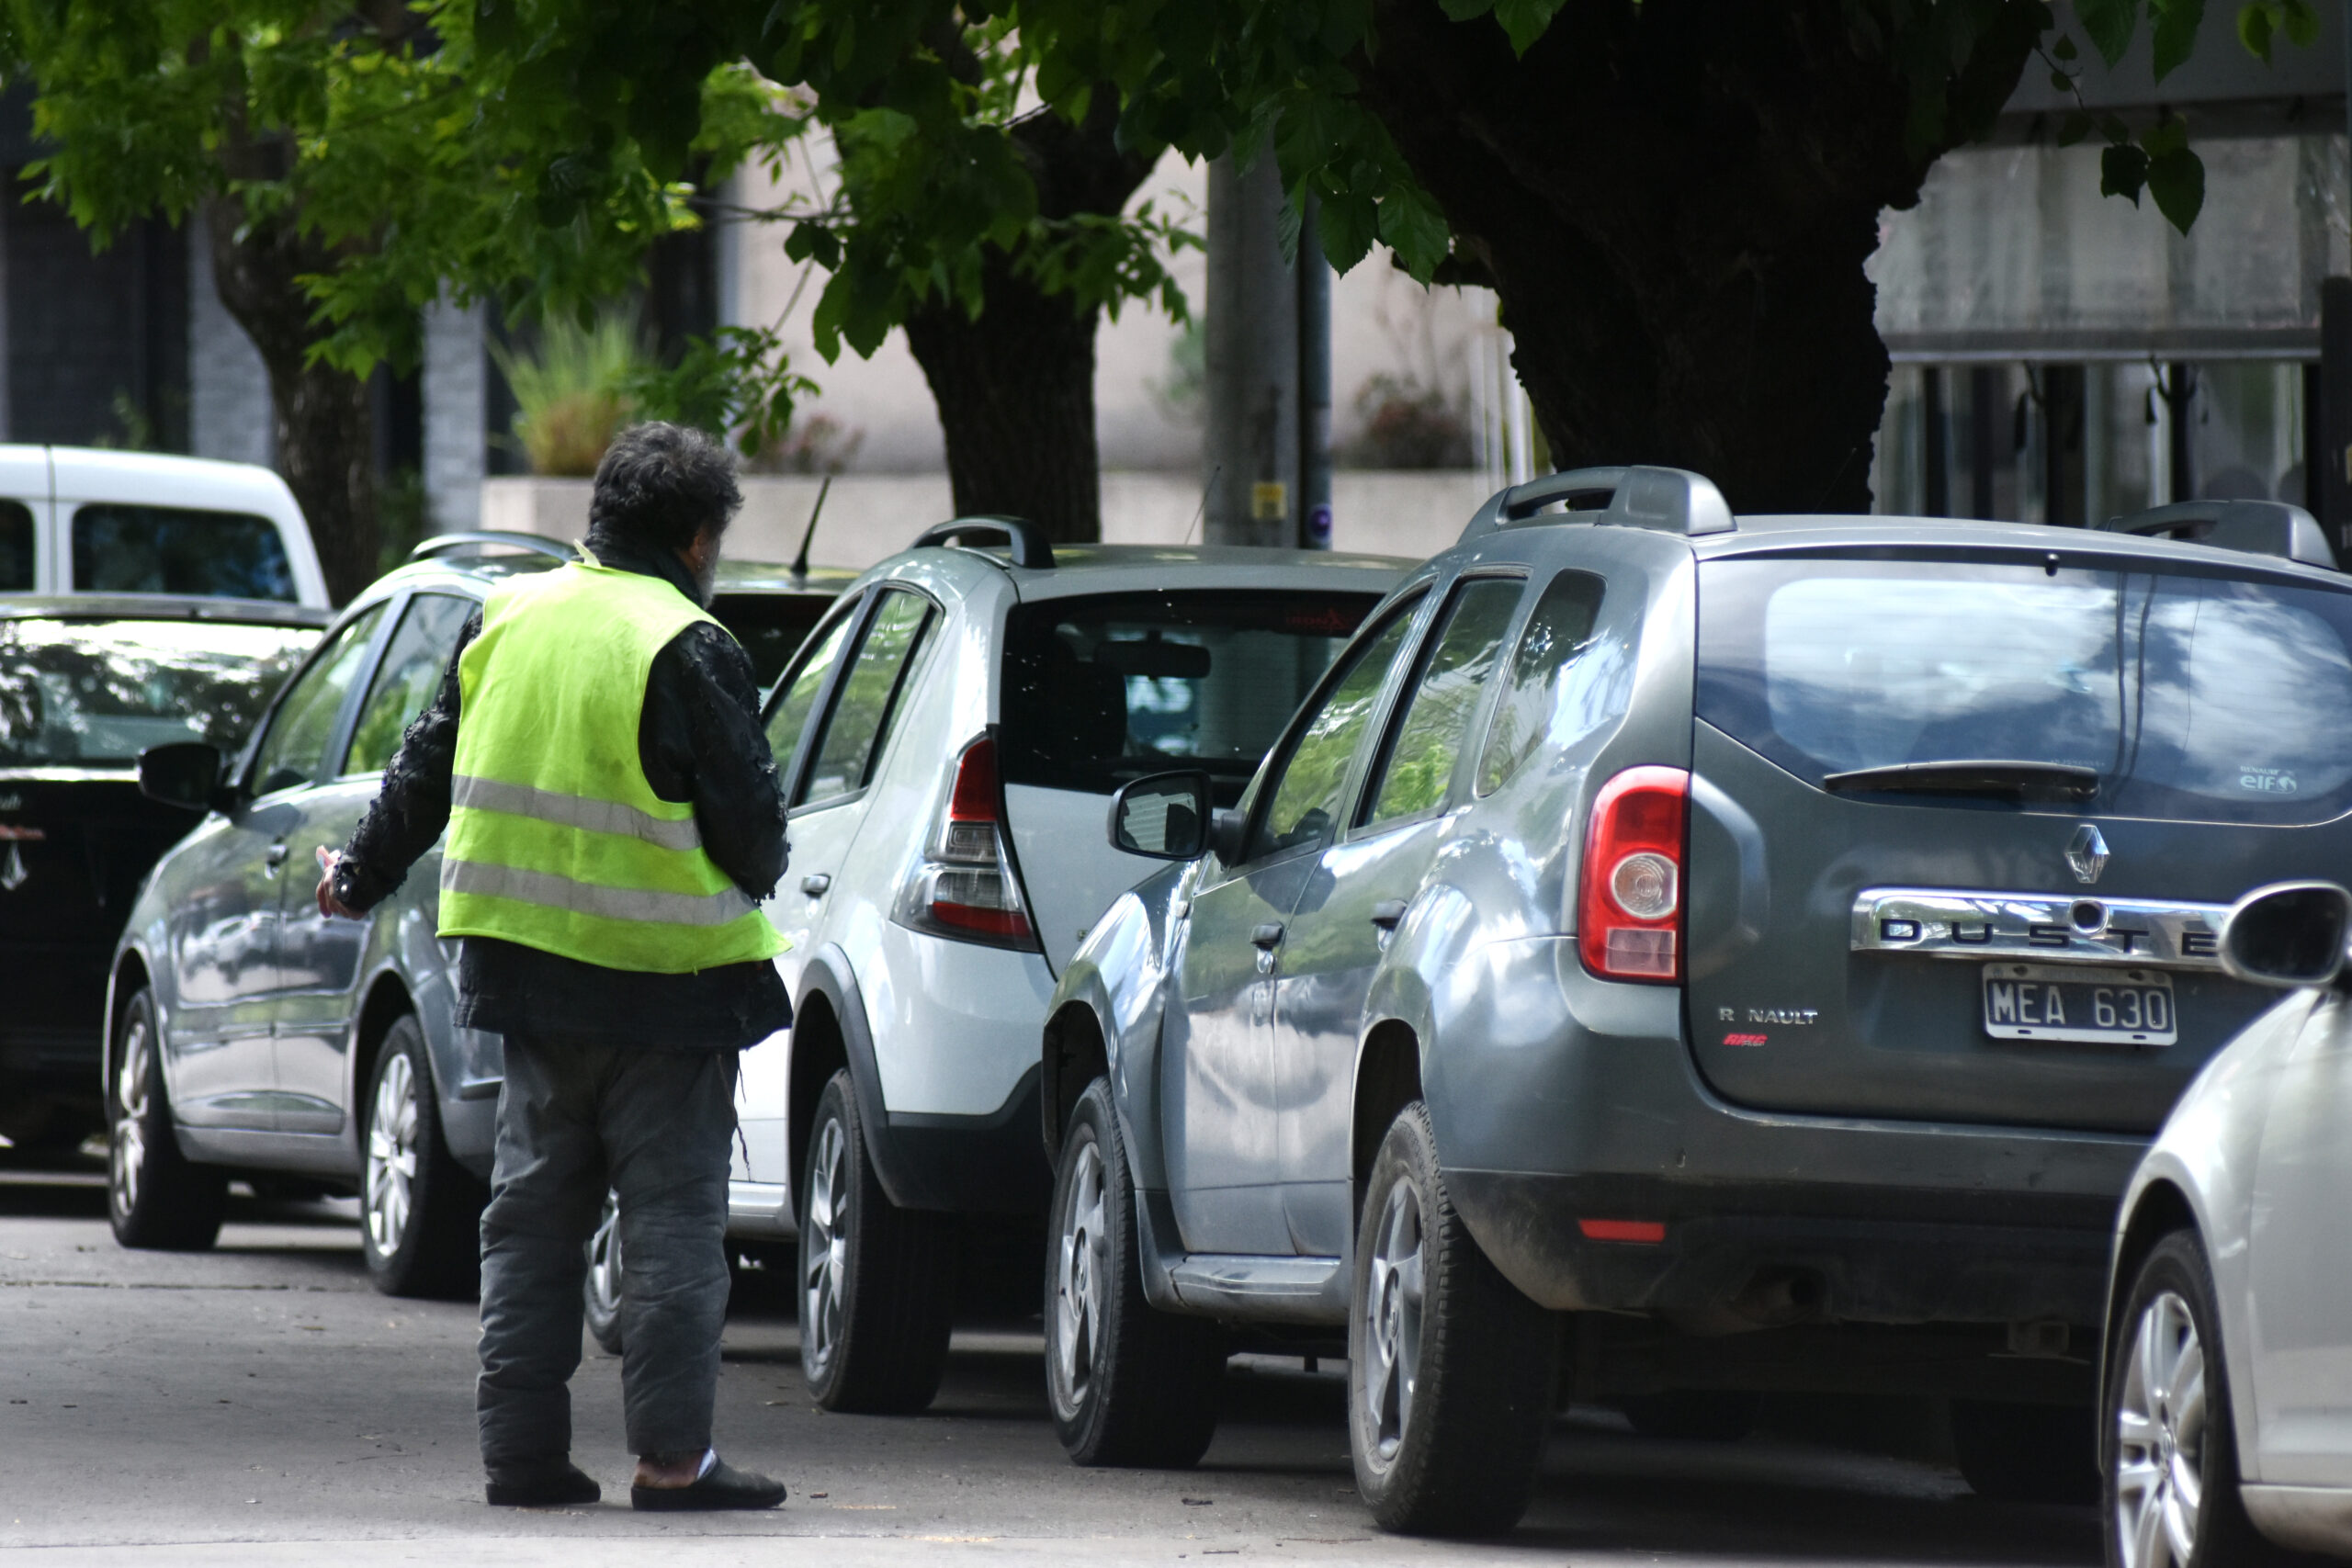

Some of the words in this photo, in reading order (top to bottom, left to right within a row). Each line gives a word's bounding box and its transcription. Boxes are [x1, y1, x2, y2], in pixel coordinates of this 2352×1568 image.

[2240, 774, 2276, 790] elf
[1879, 917, 2221, 957] DUSTE
[1719, 1007, 1818, 1025] RNAULT
[1992, 983, 2066, 1025] MEA
[2094, 987, 2168, 1031] 630
